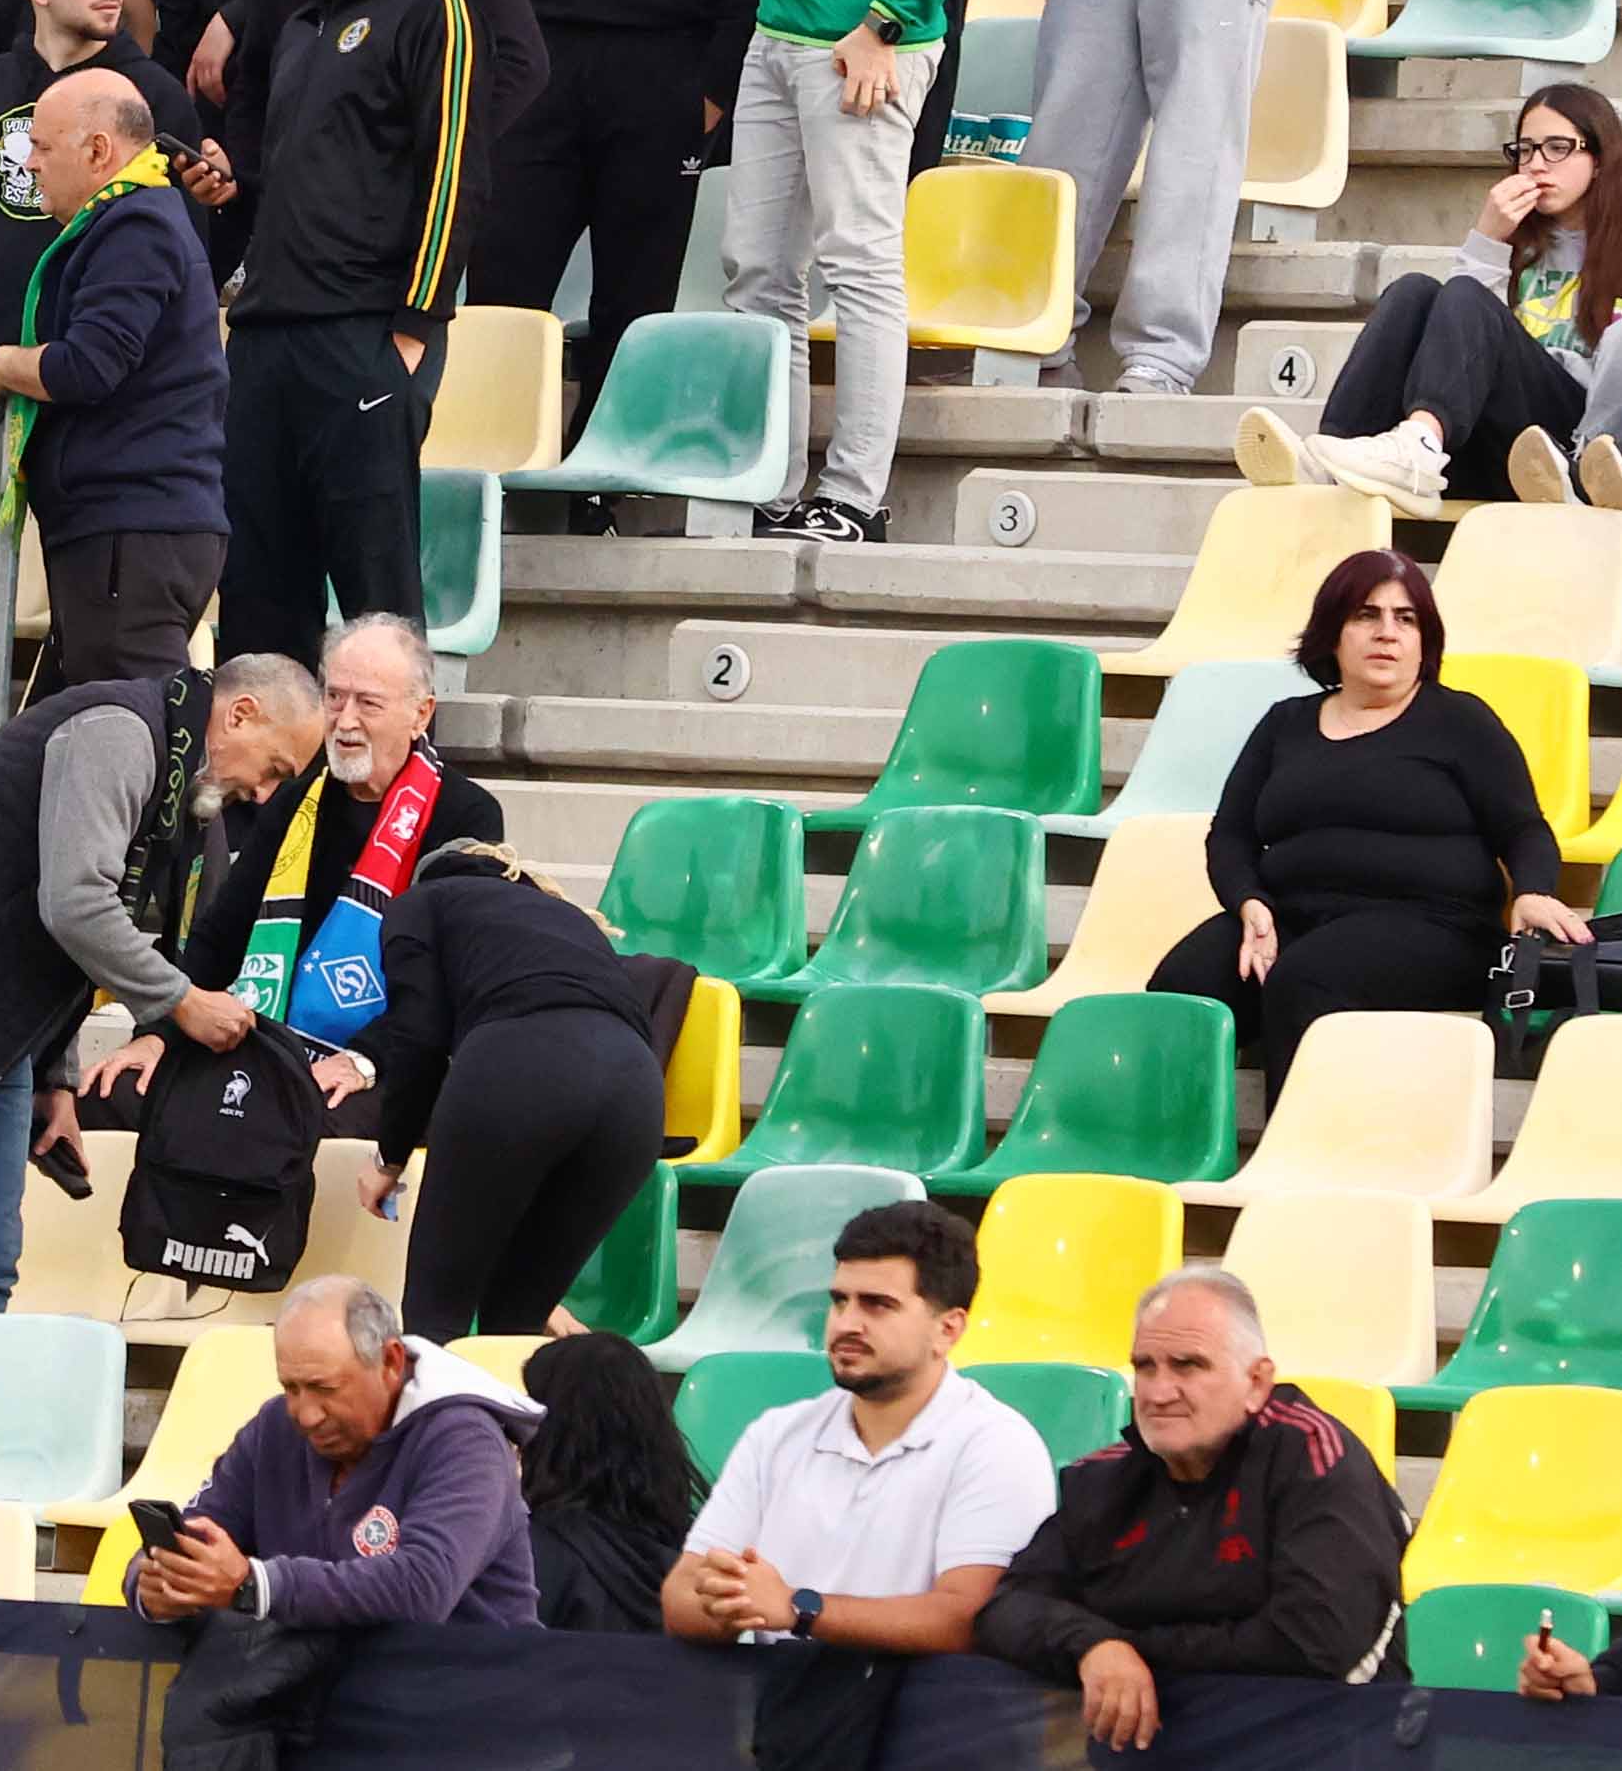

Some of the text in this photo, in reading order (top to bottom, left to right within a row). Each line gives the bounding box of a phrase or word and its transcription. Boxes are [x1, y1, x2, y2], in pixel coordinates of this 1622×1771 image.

[1278, 356, 1297, 387] 4
[999, 505, 1018, 532] 3
[712, 654, 733, 686] 2
[161, 1237, 256, 1280] PUMA
